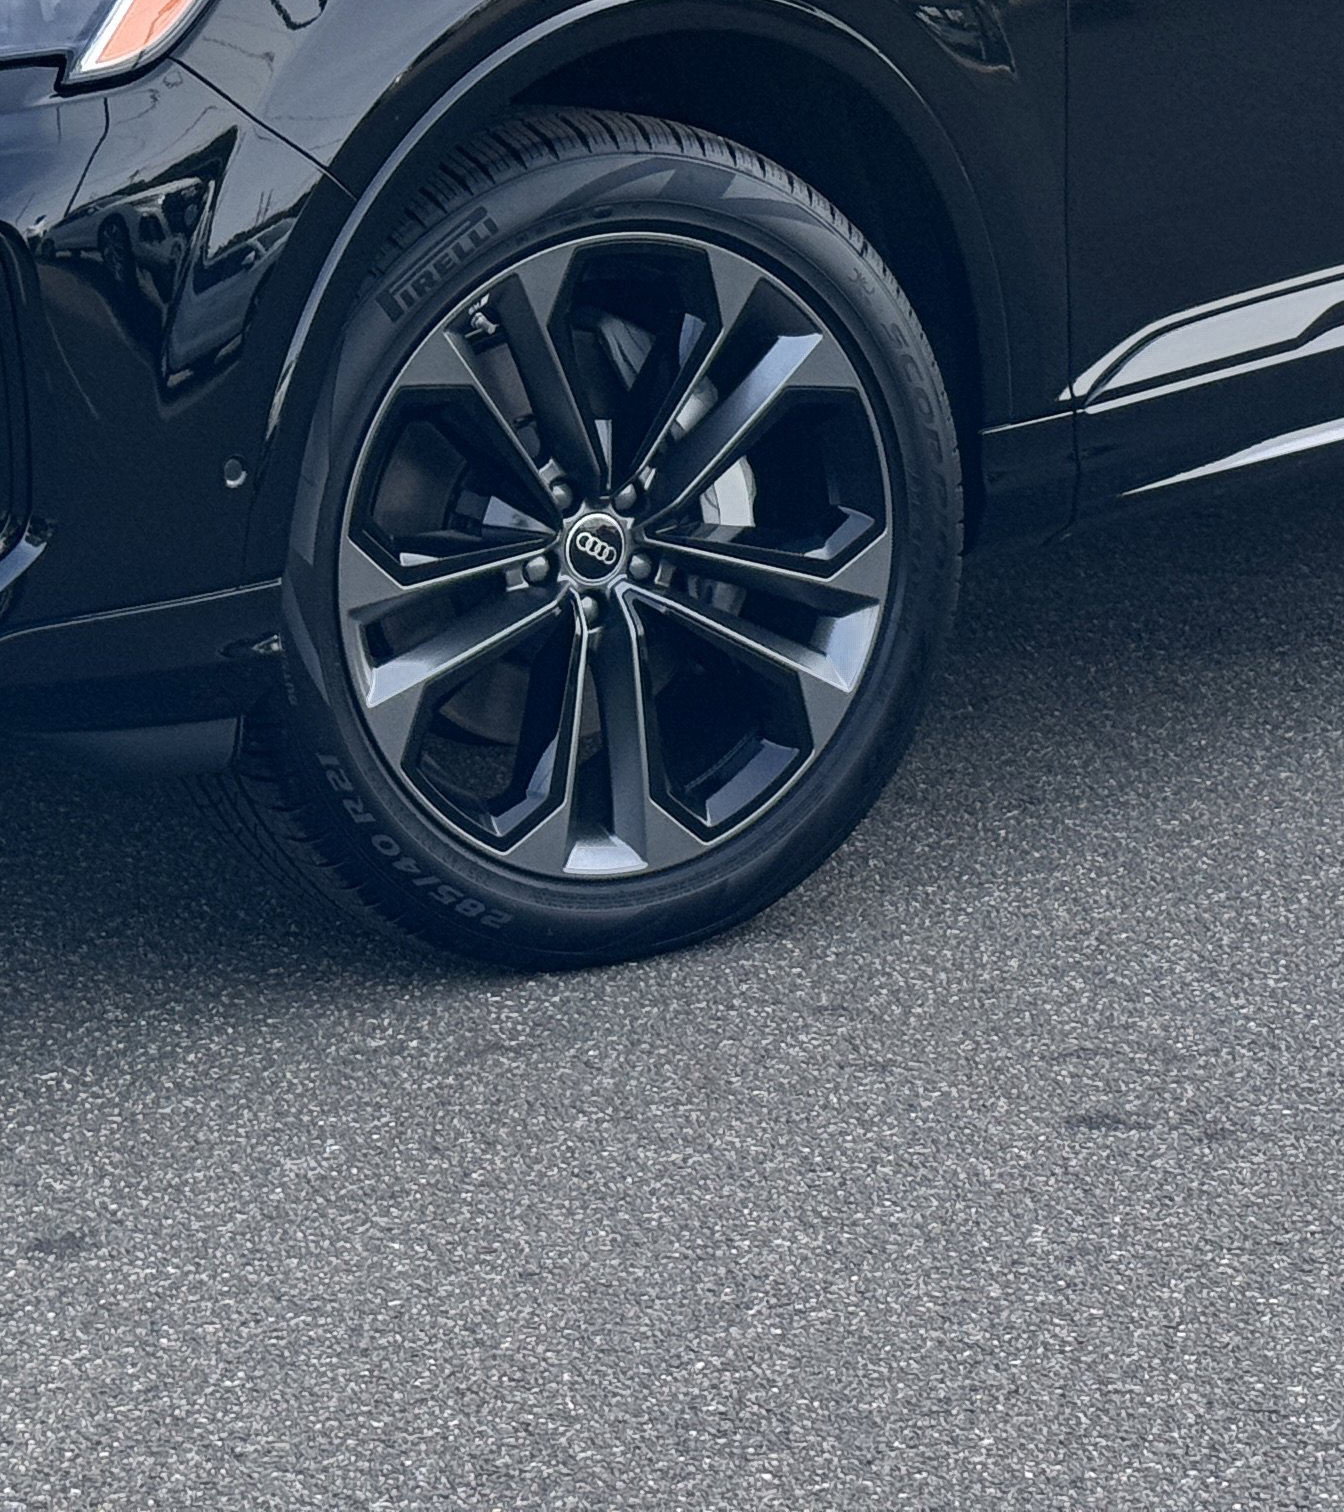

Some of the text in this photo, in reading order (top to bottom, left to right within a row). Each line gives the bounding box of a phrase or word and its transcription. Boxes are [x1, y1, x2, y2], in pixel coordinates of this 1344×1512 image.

[376, 207, 500, 322] PIRELLI
[316, 754, 377, 826] R21
[372, 833, 513, 929] 285/40
